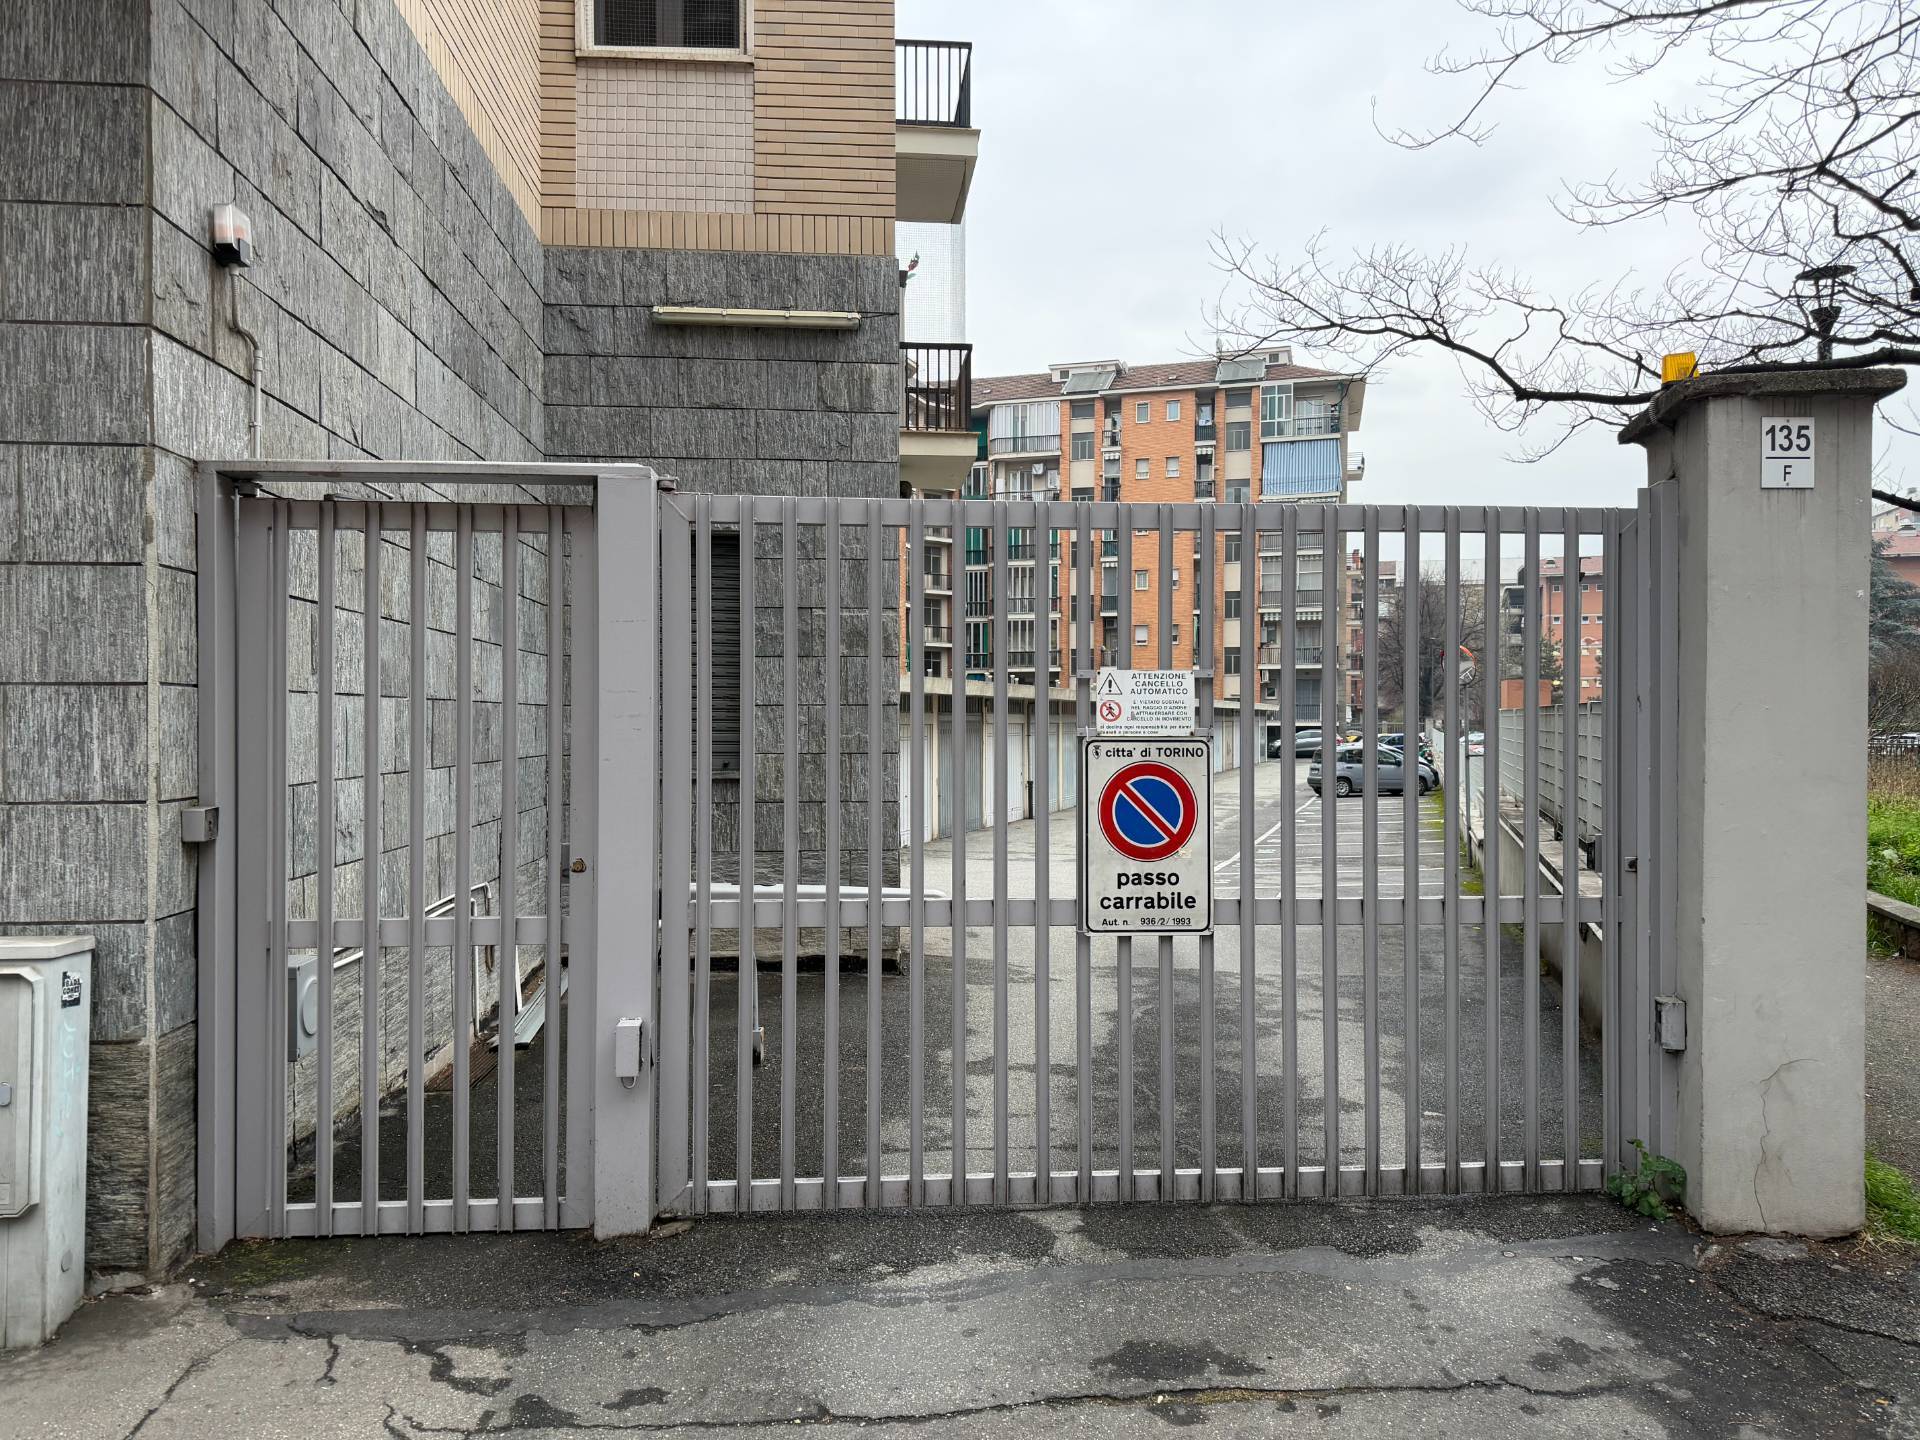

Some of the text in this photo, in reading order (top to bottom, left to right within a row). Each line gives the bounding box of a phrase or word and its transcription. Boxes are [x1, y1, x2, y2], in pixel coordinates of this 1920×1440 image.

[1765, 424, 1811, 452] 135
[1783, 464, 1793, 482] F
[1105, 747, 1204, 758] citta' di TORINO
[1117, 872, 1180, 889] passo
[1100, 891, 1197, 910] carrabile
[1101, 918, 1120, 926] Aut.
